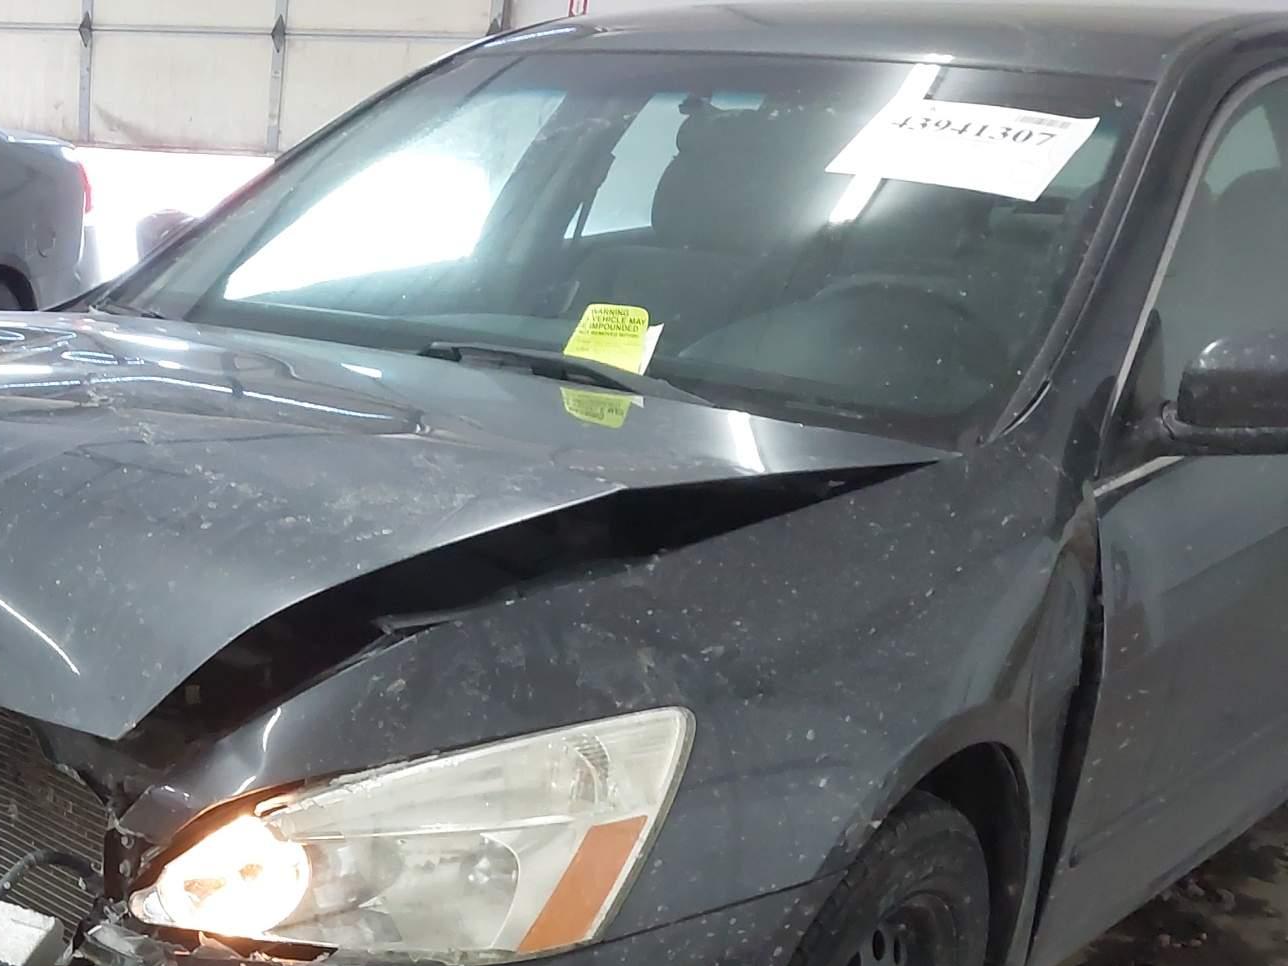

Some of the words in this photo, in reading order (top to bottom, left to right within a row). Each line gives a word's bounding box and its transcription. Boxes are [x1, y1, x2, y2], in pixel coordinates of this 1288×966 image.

[891, 116, 1057, 146] 43941307
[591, 308, 630, 316] WARNING
[592, 315, 625, 324] VEHICLE
[629, 317, 646, 325] MAY
[589, 322, 639, 332] IMPOUNDED
